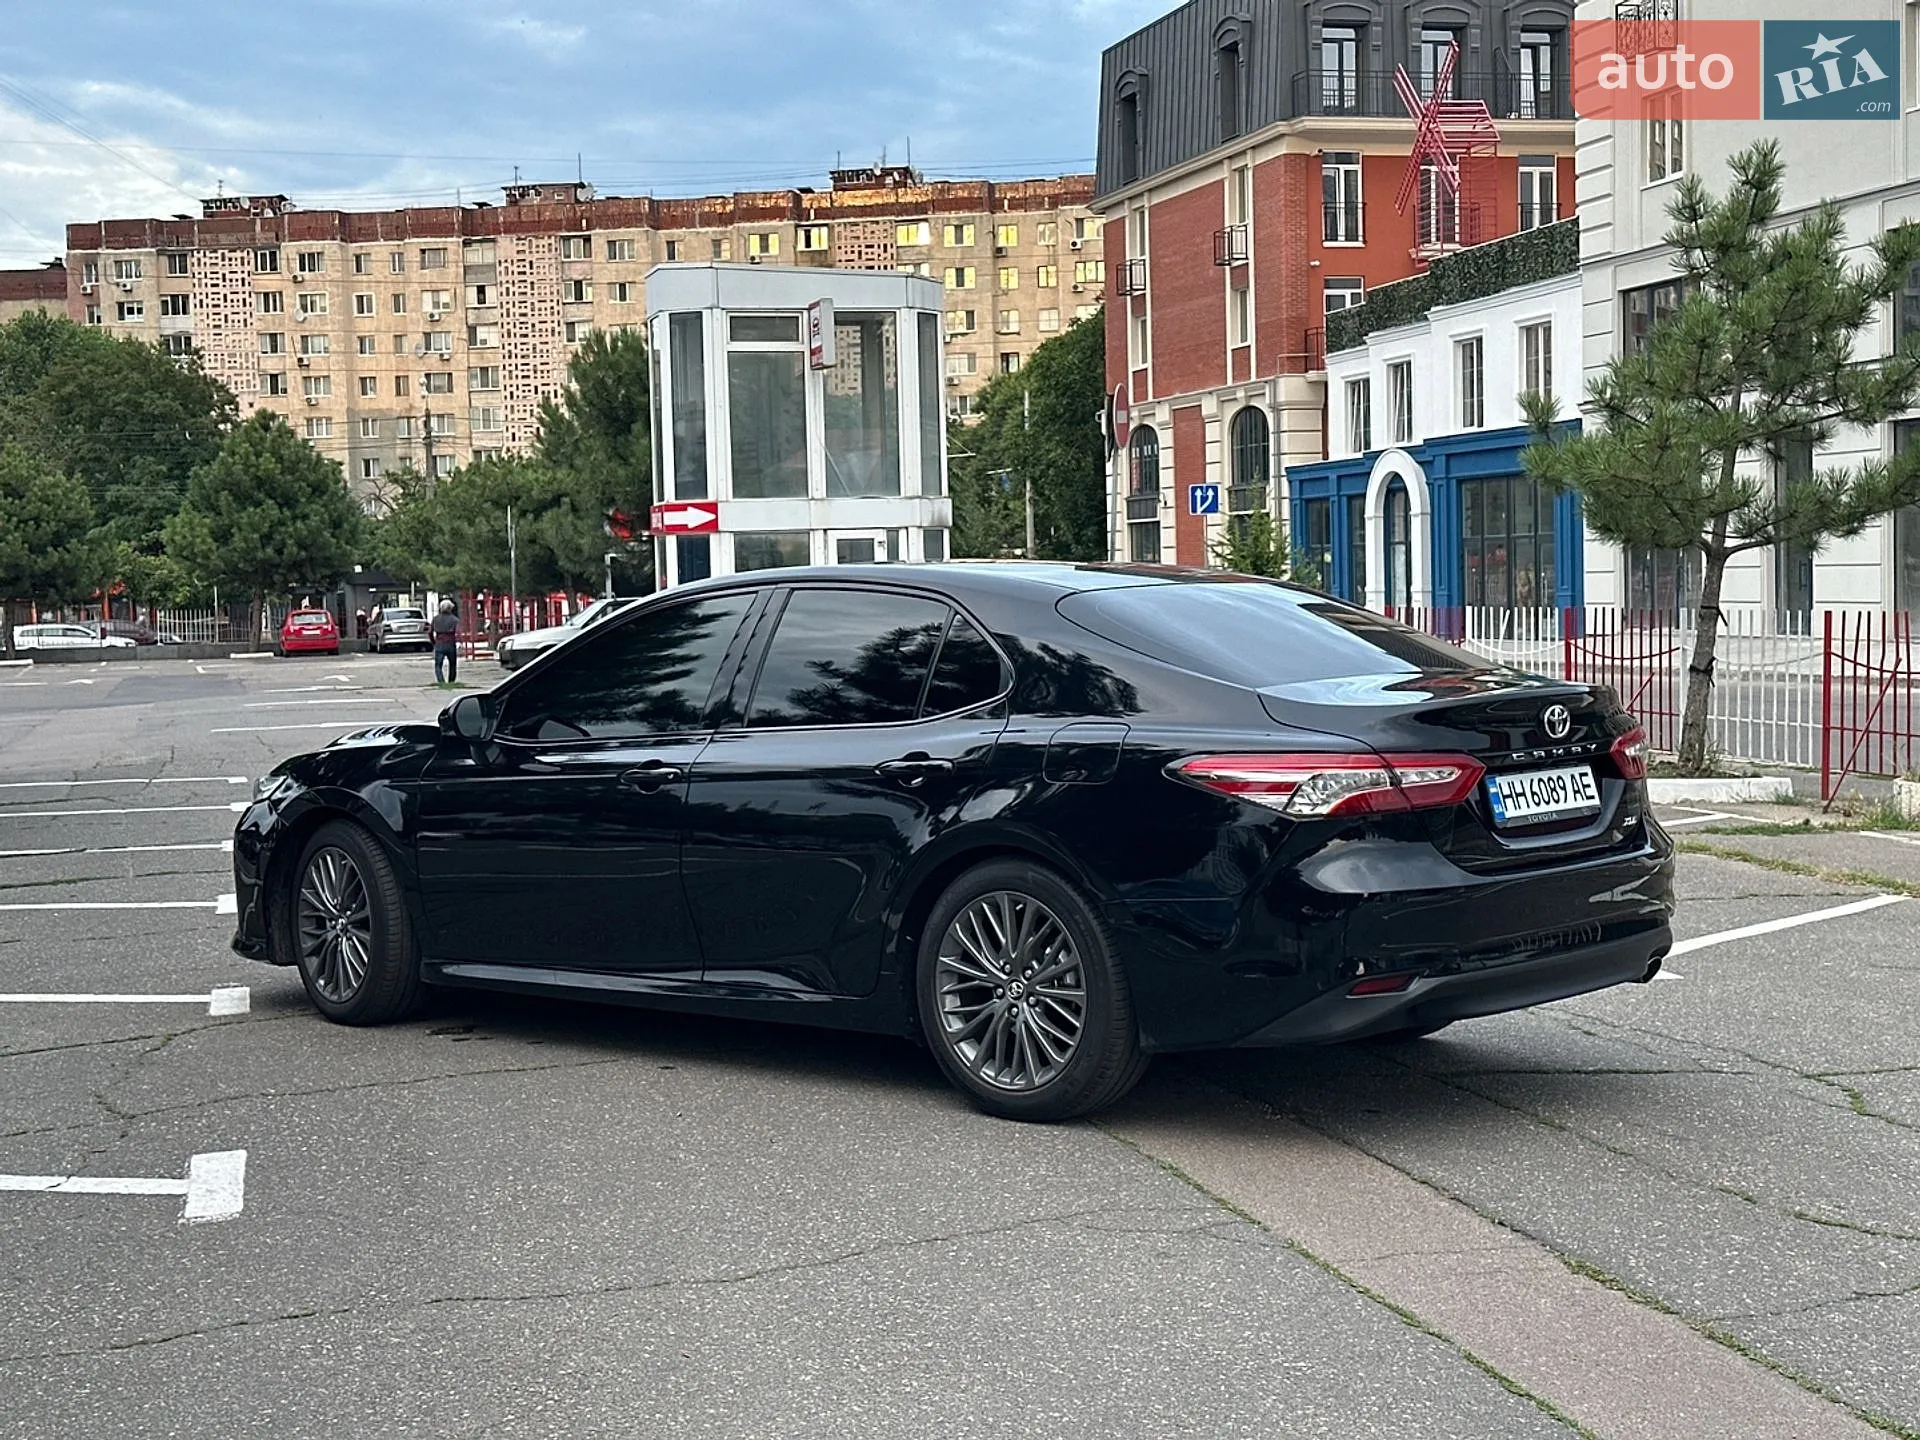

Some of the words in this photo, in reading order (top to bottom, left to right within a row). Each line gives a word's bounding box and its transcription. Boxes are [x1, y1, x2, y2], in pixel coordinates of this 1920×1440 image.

[1512, 743, 1597, 760] CAMRY
[1530, 775, 1568, 807] 6089
[1570, 772, 1596, 802] AE
[1527, 812, 1559, 823] TOYOTA
